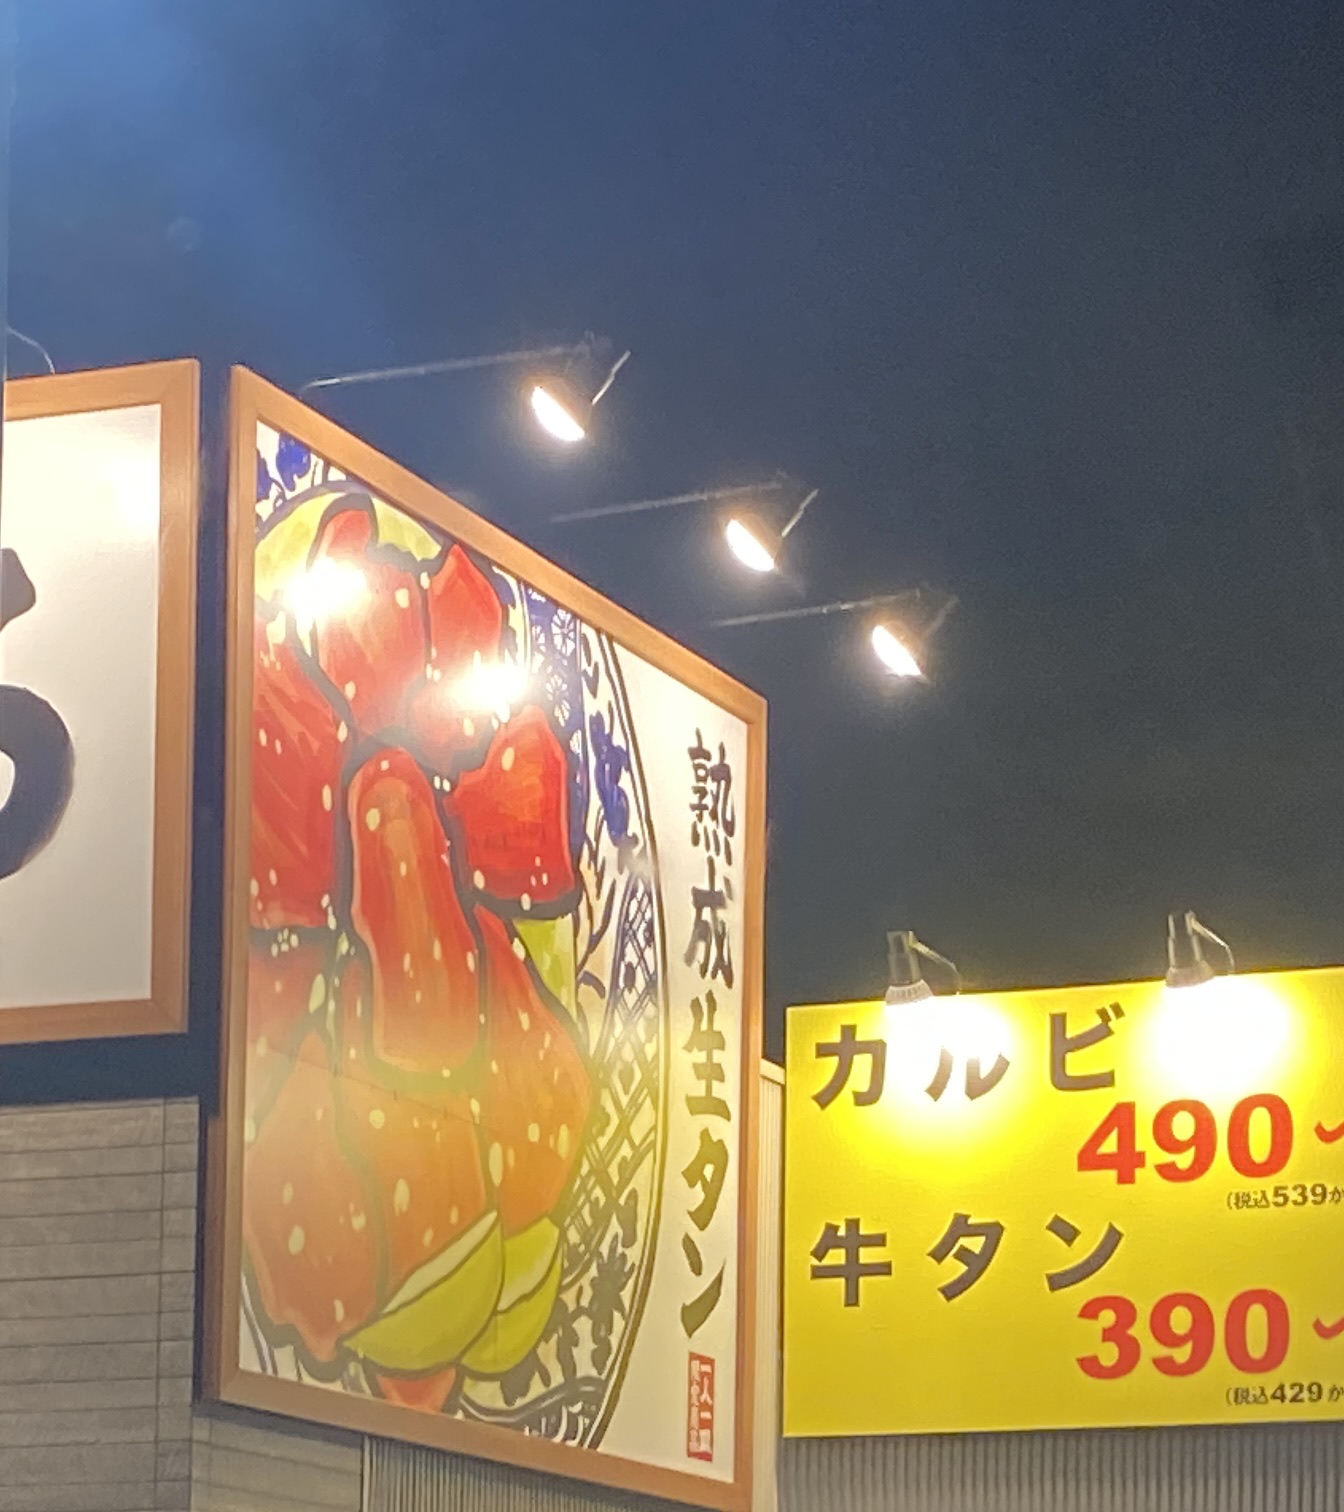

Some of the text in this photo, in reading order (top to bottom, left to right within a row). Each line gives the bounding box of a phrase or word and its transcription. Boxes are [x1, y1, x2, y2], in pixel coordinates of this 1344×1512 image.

[678, 727, 737, 1340] 熟成生タン
[810, 1001, 1126, 1111] カルビ
[809, 1212, 1124, 1307] 牛タン
